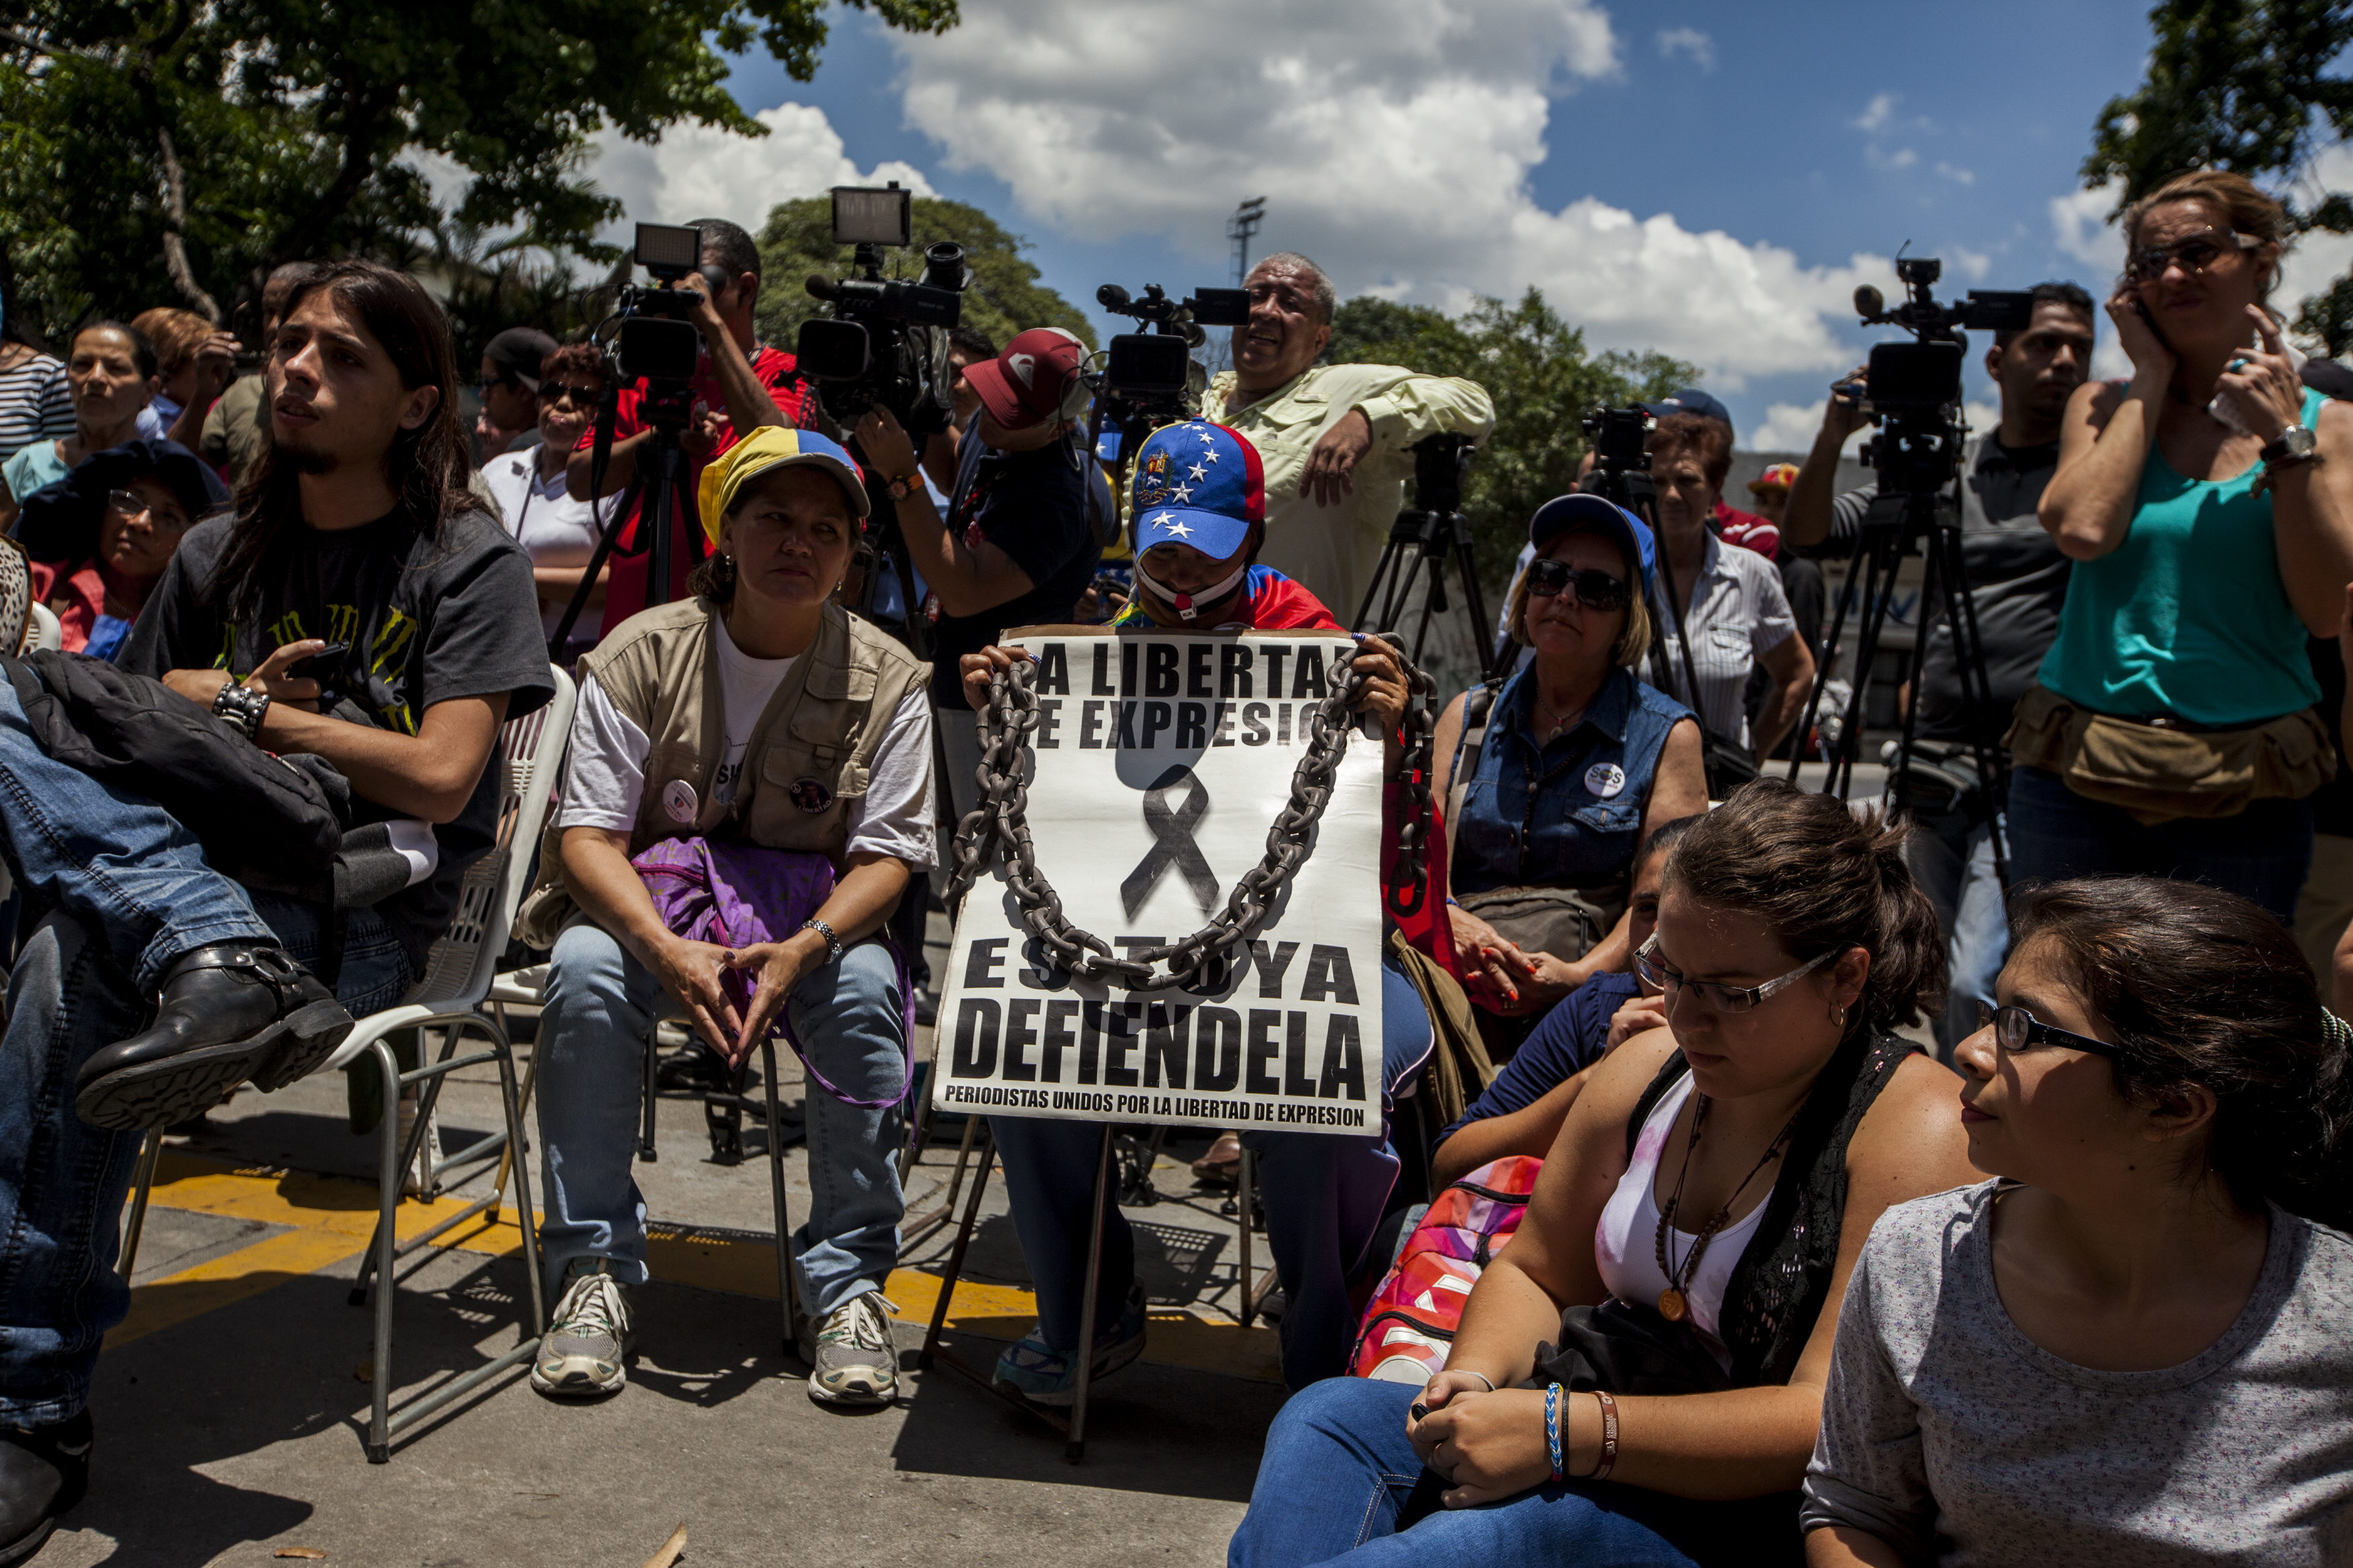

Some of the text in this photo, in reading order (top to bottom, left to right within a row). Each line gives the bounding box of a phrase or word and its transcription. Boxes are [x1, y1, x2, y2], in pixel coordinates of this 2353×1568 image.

[1091, 643, 1357, 699] LIBERTA
[1589, 766, 1622, 784] SOS
[963, 937, 1072, 992] ES
[951, 997, 1366, 1101] DEFIENDELA
[945, 1085, 1364, 1127] PERIODISTAS UNIDOS POR LA LIBERTAD DE EXPRESION
